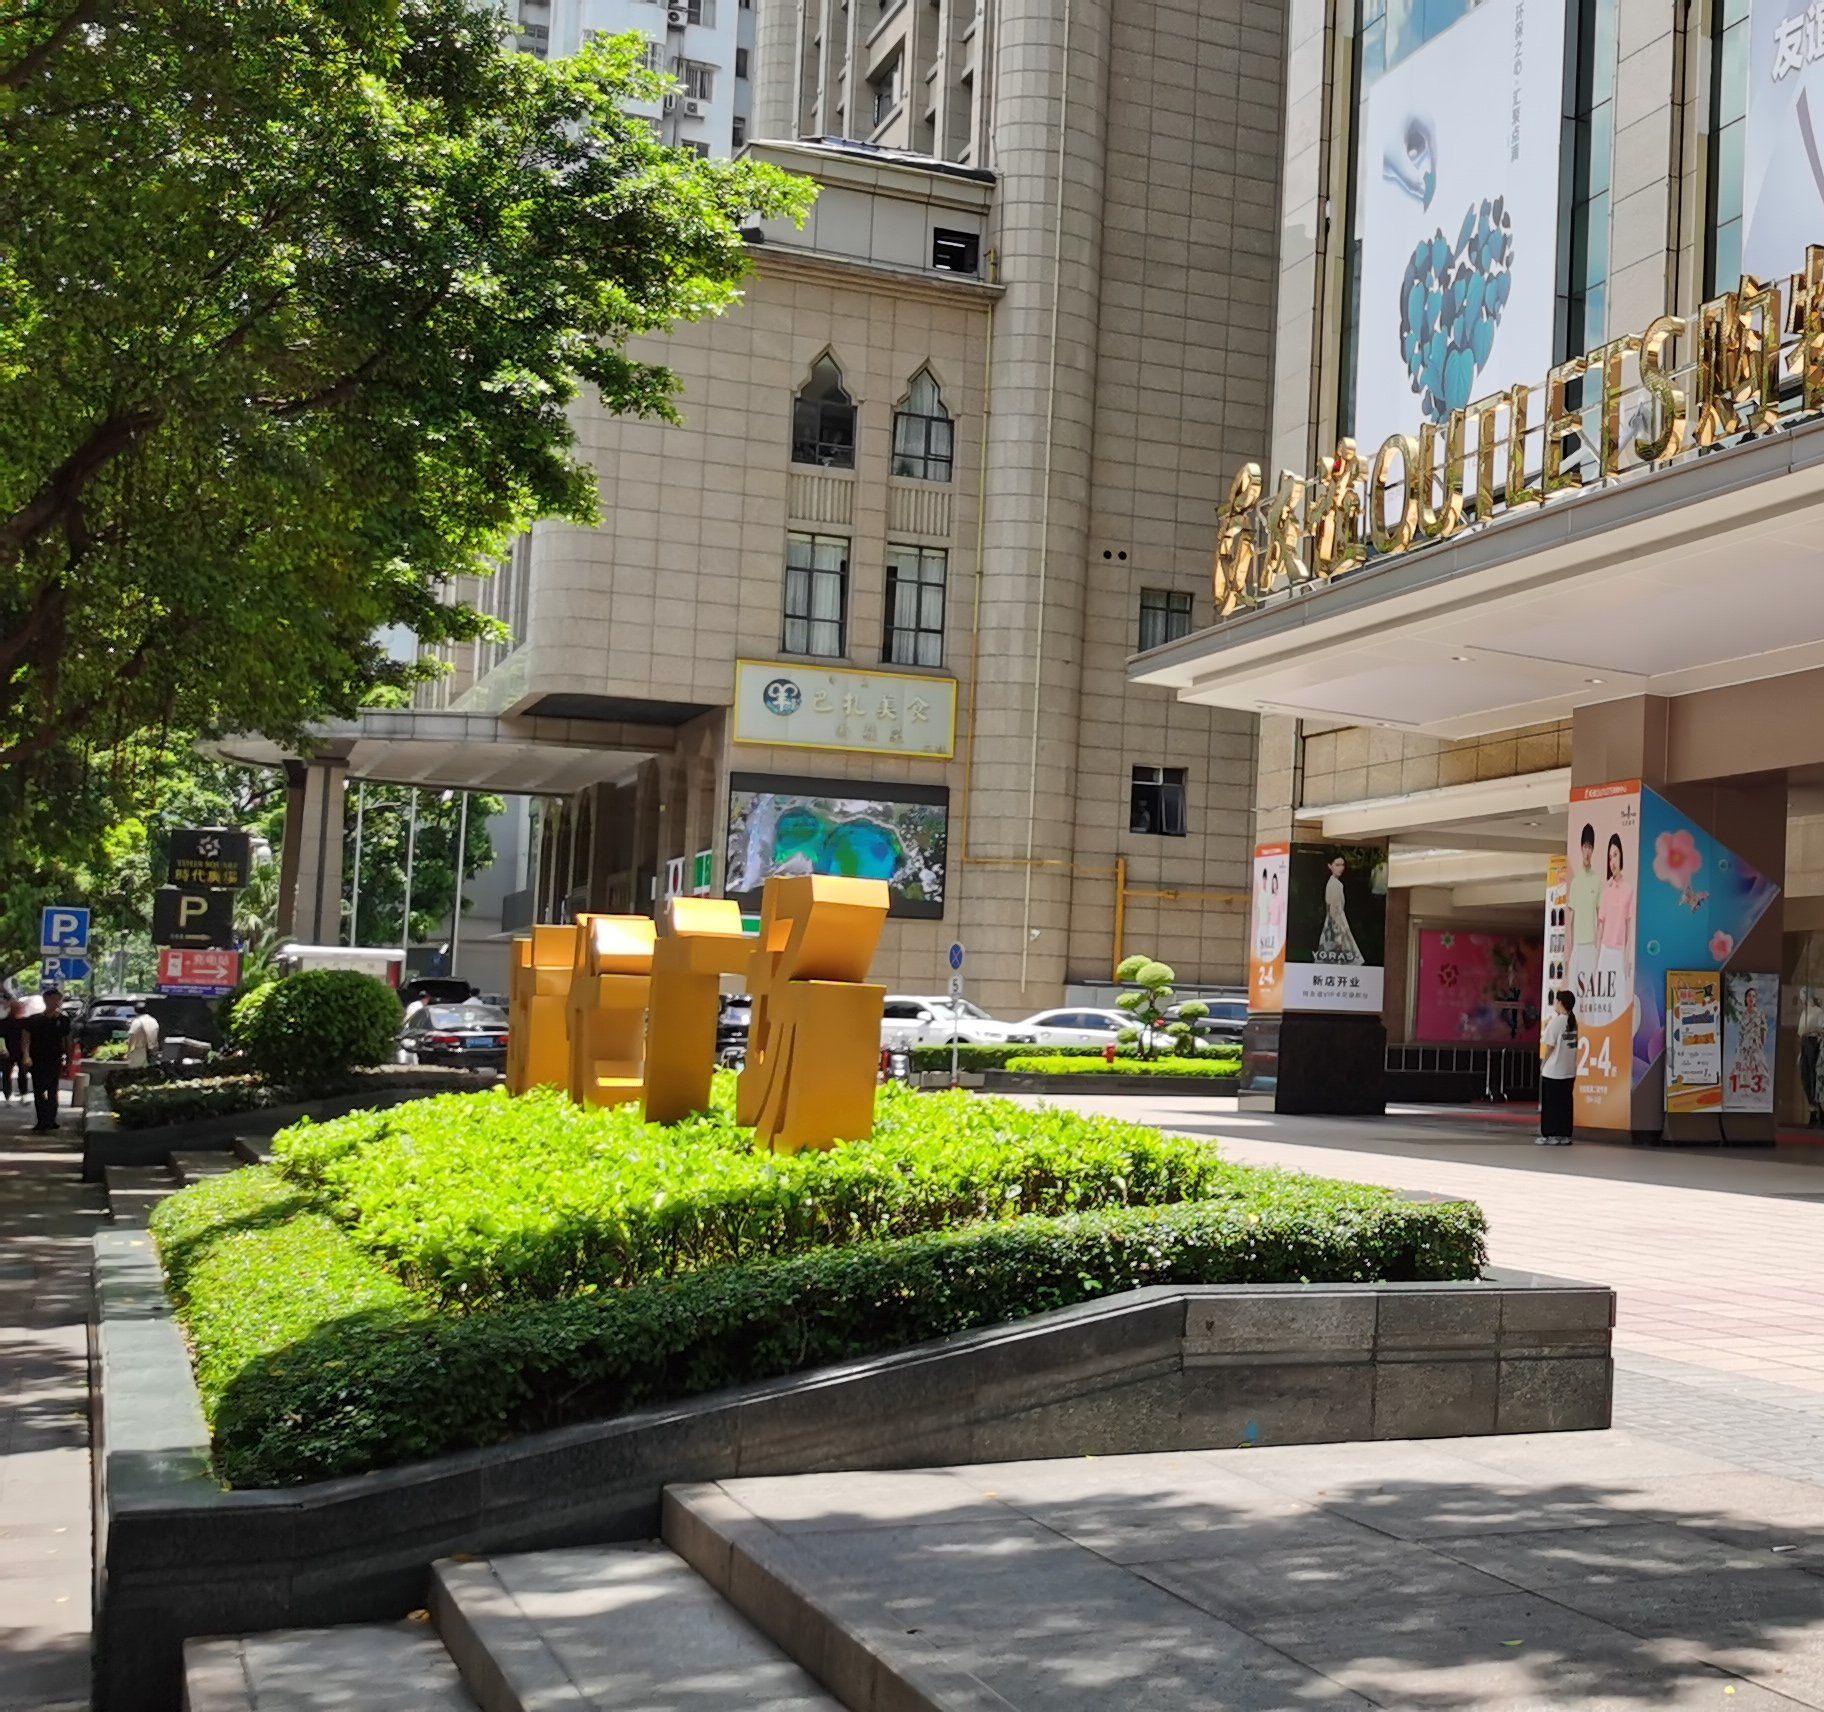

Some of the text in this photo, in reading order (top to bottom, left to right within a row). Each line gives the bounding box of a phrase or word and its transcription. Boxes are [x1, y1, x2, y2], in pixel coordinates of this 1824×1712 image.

[179, 896, 208, 927] P
[51, 913, 79, 943] P
[44, 957, 61, 975] P
[1312, 975, 1360, 988] 新店开业
[1576, 970, 1617, 998] SALE
